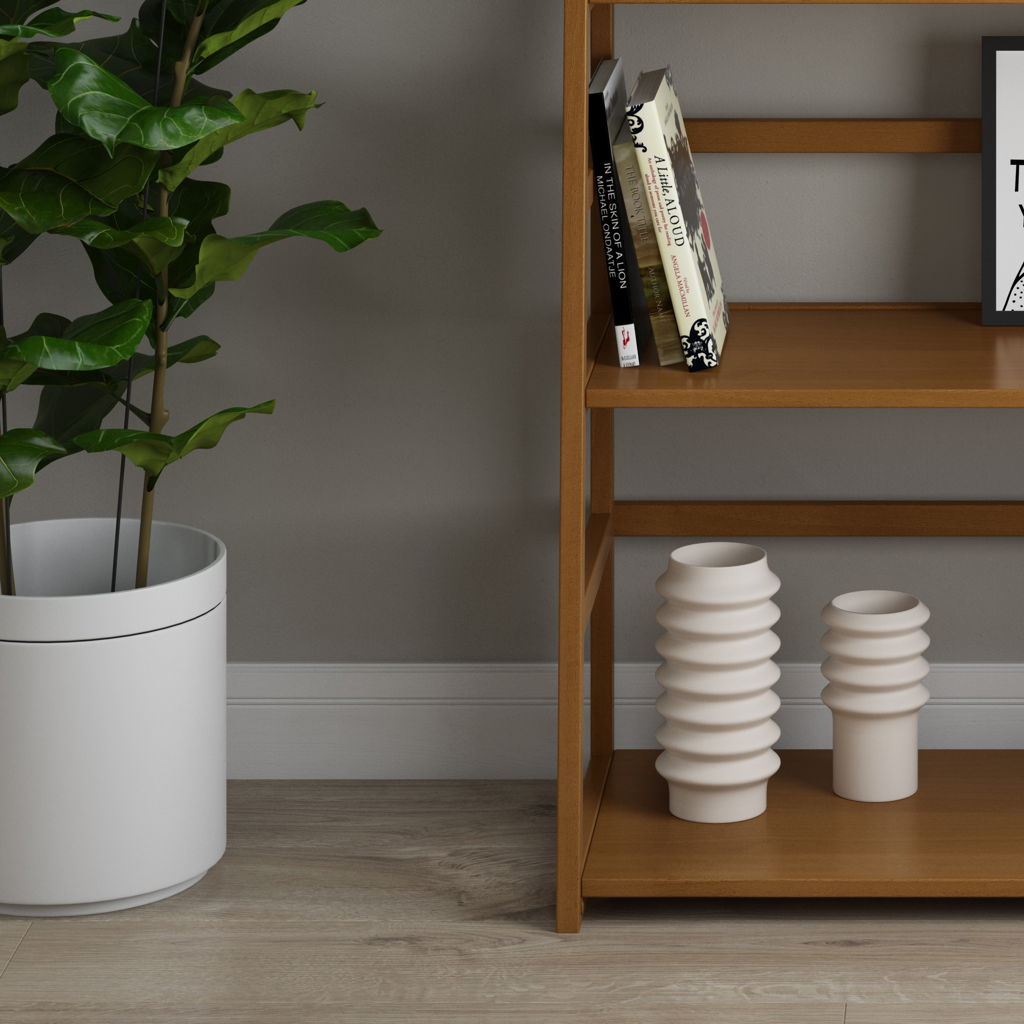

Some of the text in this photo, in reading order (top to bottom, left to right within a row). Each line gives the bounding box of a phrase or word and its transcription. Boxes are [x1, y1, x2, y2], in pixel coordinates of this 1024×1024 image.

[596, 176, 616, 278] MICHAEL ONDAATJE
[604, 162, 628, 289] IN THE SKIN OF A LION
[654, 155, 686, 247] A Little, ALOUD
[671, 255, 690, 318] ANGELA MACMILLAN
